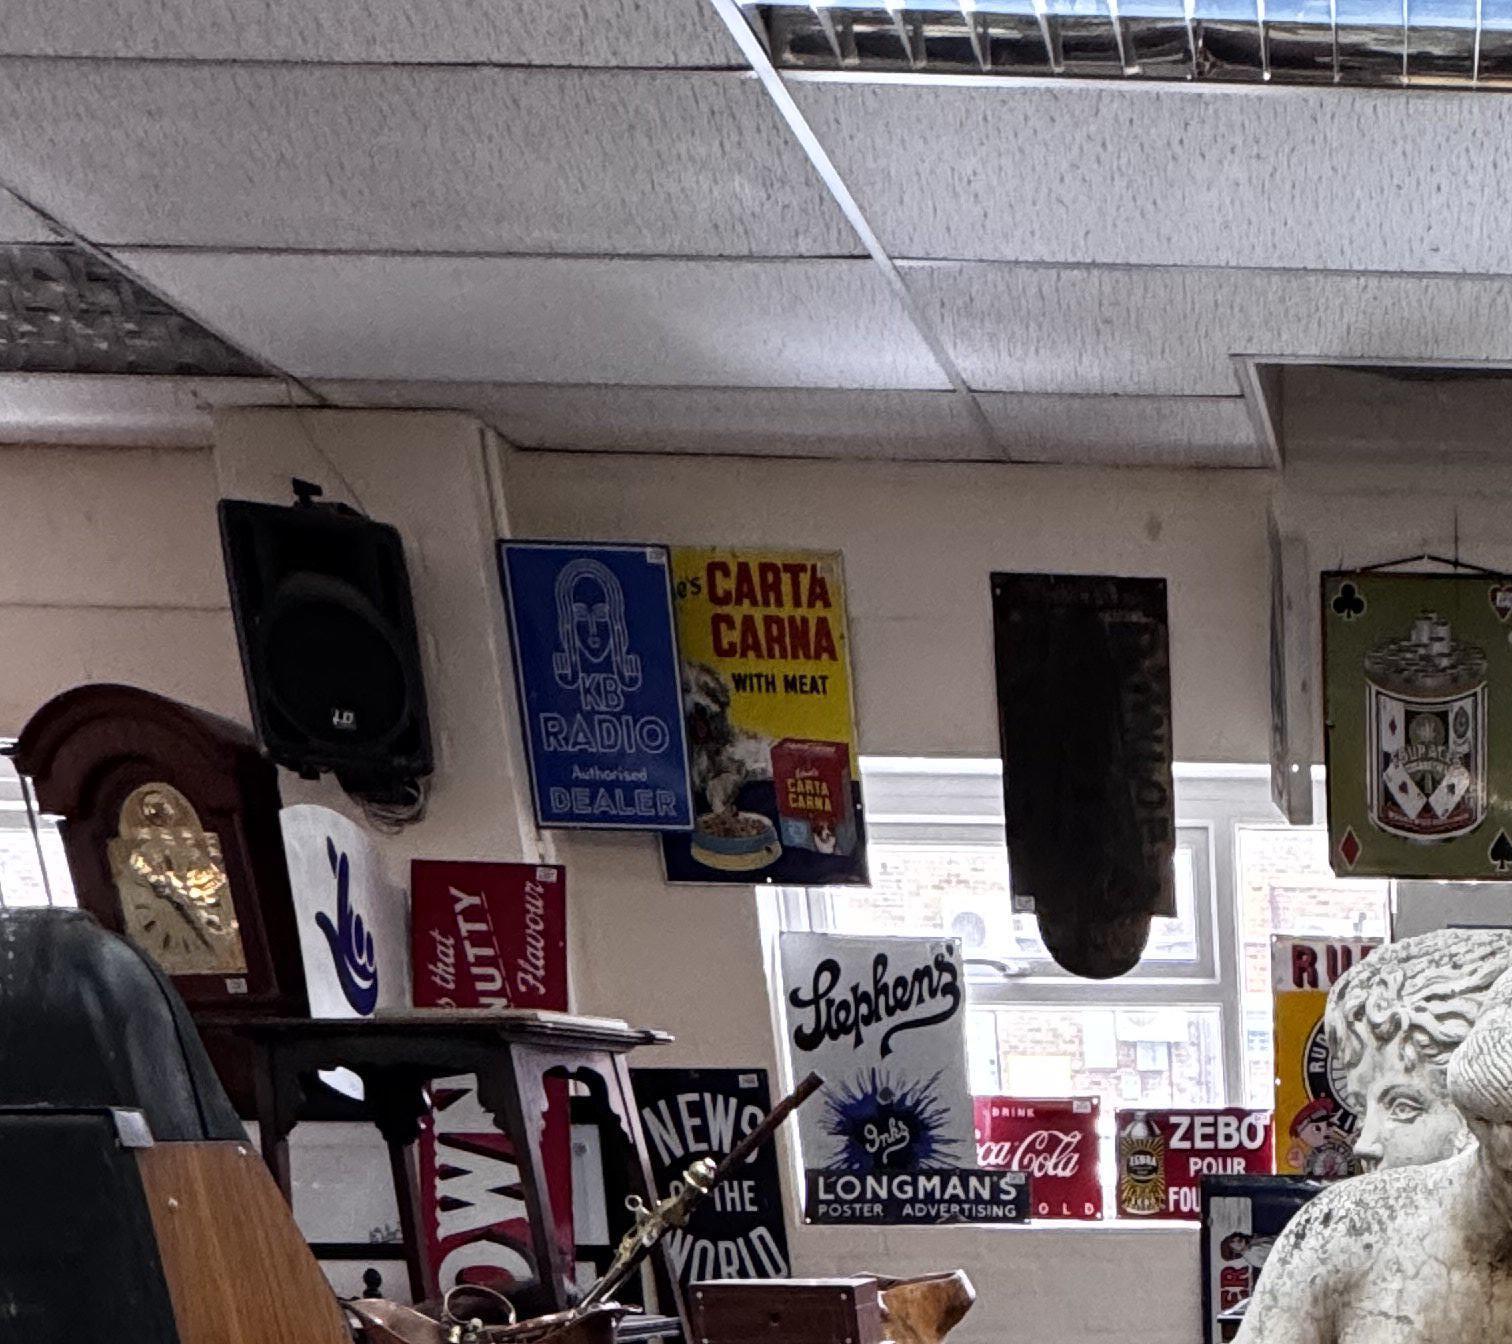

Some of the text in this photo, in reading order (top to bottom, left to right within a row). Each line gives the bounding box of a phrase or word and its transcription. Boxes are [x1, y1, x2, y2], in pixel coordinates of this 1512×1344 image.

[673, 560, 833, 609] e's CARTA
[711, 613, 838, 662] CARNA
[579, 672, 626, 712] KB
[731, 673, 829, 697] WITH MEAT
[540, 712, 670, 754] RADIO
[572, 764, 648, 782] Authorised
[550, 787, 679, 816] DEALER
[449, 886, 509, 1010] NUTTY
[518, 880, 546, 996] Flavour
[435, 929, 456, 992] that
[642, 1092, 766, 1166] NEWS
[992, 1107, 1036, 1118] DRINK
[1168, 1115, 1267, 1150] ZEBO
[863, 1116, 911, 1165] Inks
[1009, 1130, 1085, 1179] Cola
[818, 1175, 1018, 1201] LONGMAN'S
[1189, 1157, 1247, 1178] POUR
[818, 1202, 1017, 1219] POSTER ADVERTISING
